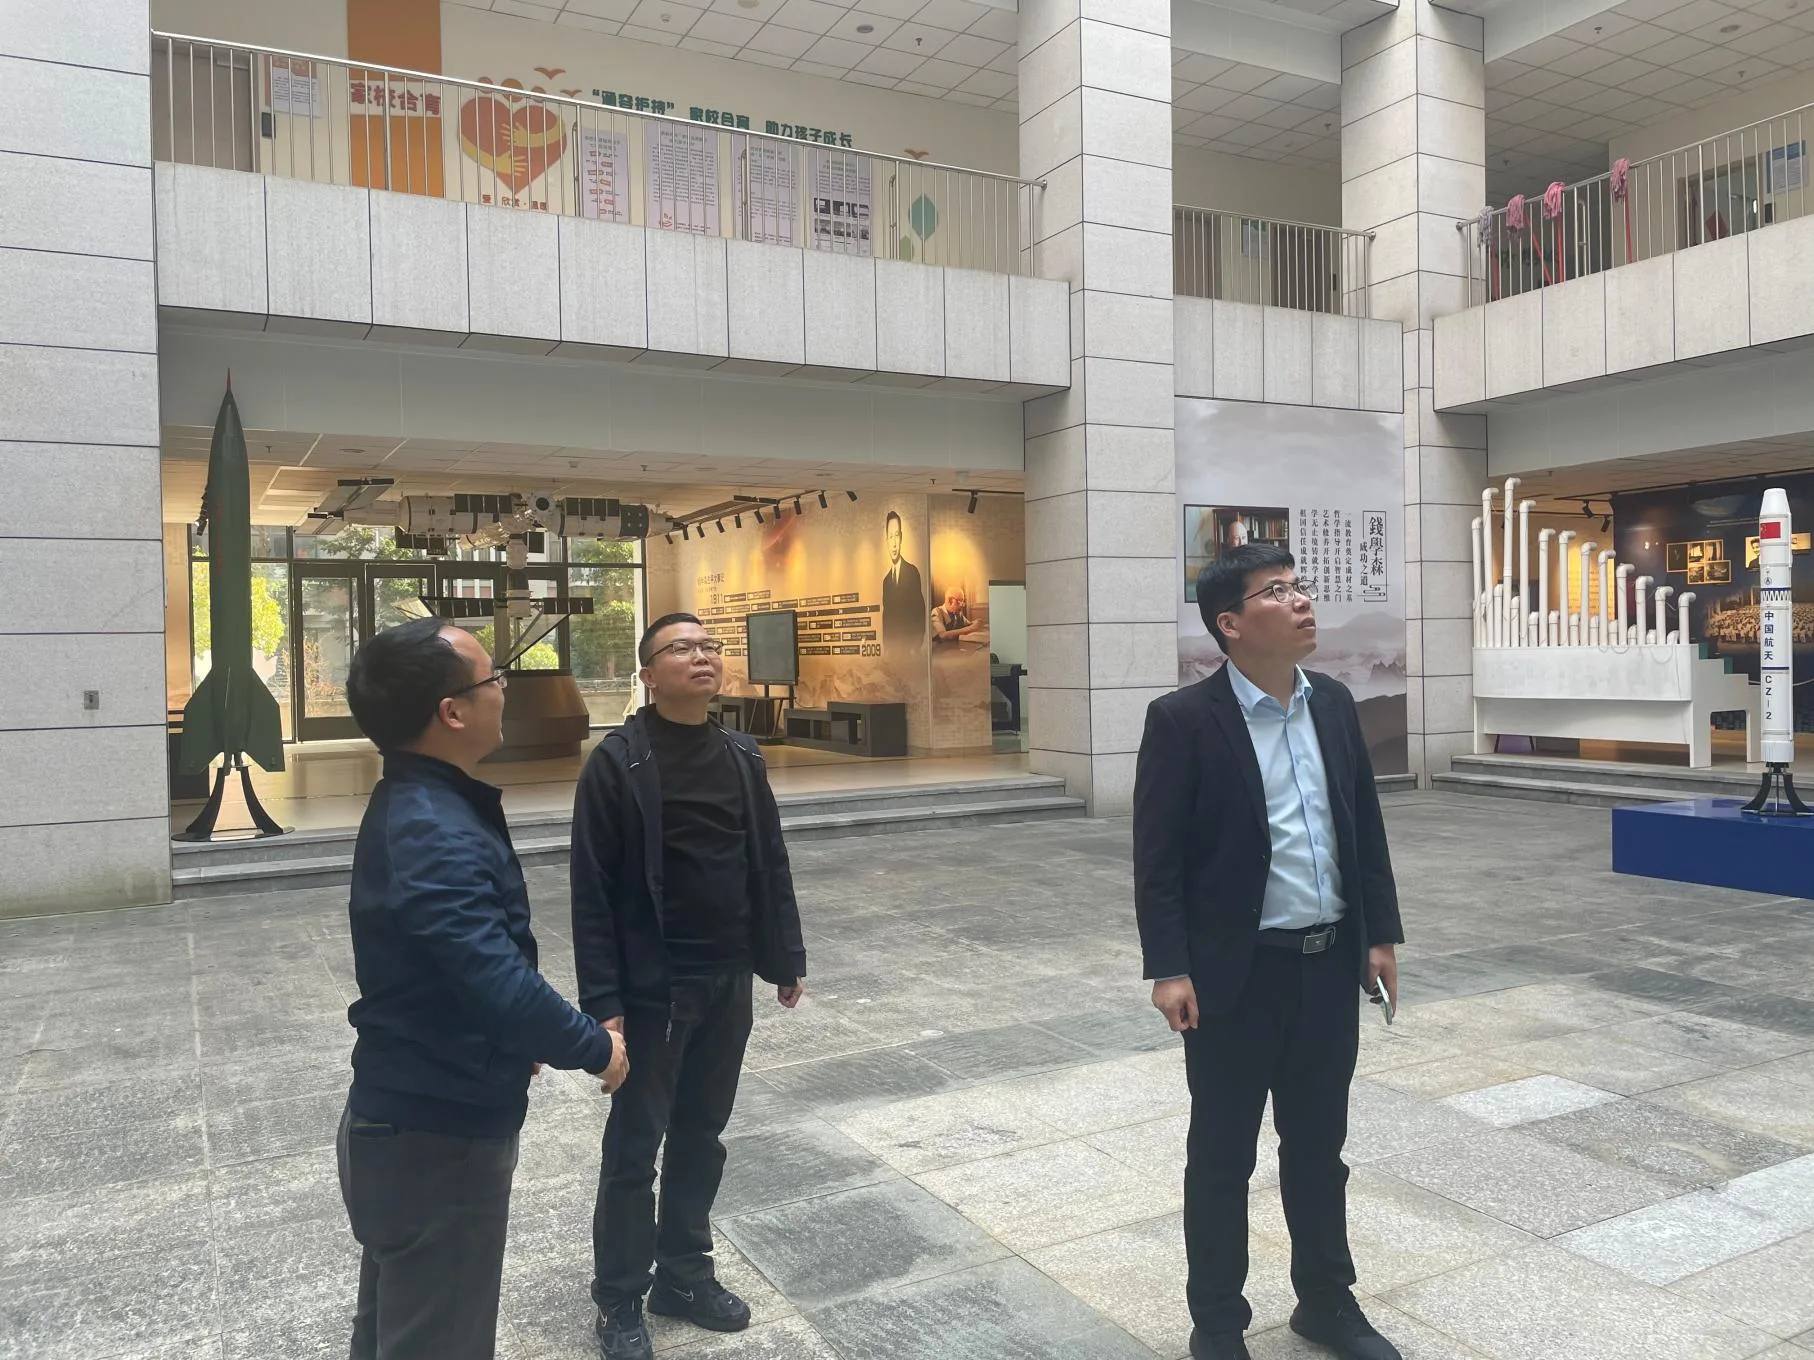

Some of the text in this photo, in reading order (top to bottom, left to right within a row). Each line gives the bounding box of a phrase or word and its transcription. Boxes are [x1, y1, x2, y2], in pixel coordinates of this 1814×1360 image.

[765, 120, 853, 148] 助力孩子成长
[1311, 509, 1319, 602] 学无止境铸就学术
[1360, 541, 1368, 586] 成功之道
[861, 643, 881, 657] 2009
[1764, 611, 1774, 661] 中国航天
